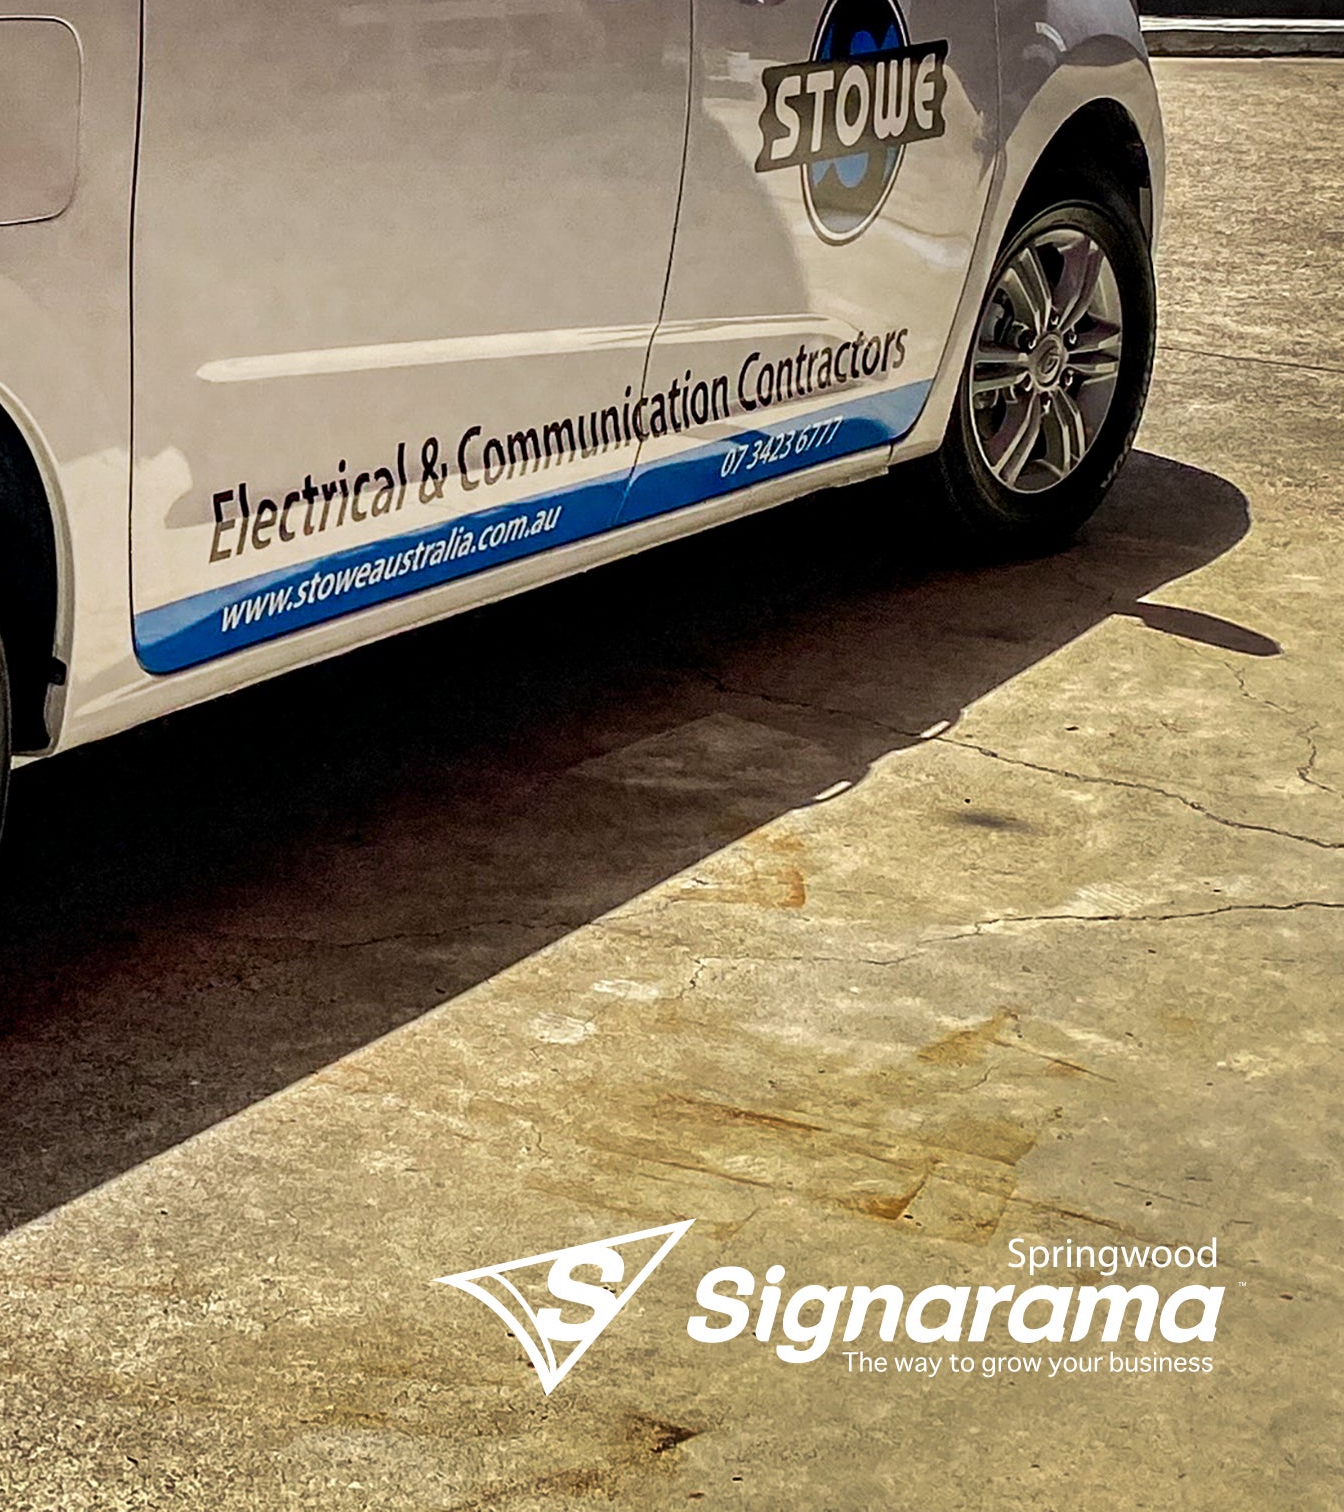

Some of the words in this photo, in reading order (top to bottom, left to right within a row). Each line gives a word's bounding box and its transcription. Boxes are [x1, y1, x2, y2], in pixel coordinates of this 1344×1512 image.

[769, 52, 938, 161] STOWE
[209, 444, 408, 564] Electrical
[418, 438, 449, 503] &
[457, 368, 731, 492] Communication
[737, 324, 909, 412] Contractors
[720, 443, 749, 478] 07
[746, 430, 796, 470] 3423
[795, 415, 844, 455] 6777
[220, 504, 562, 633] www.stoweaustralia.com.au
